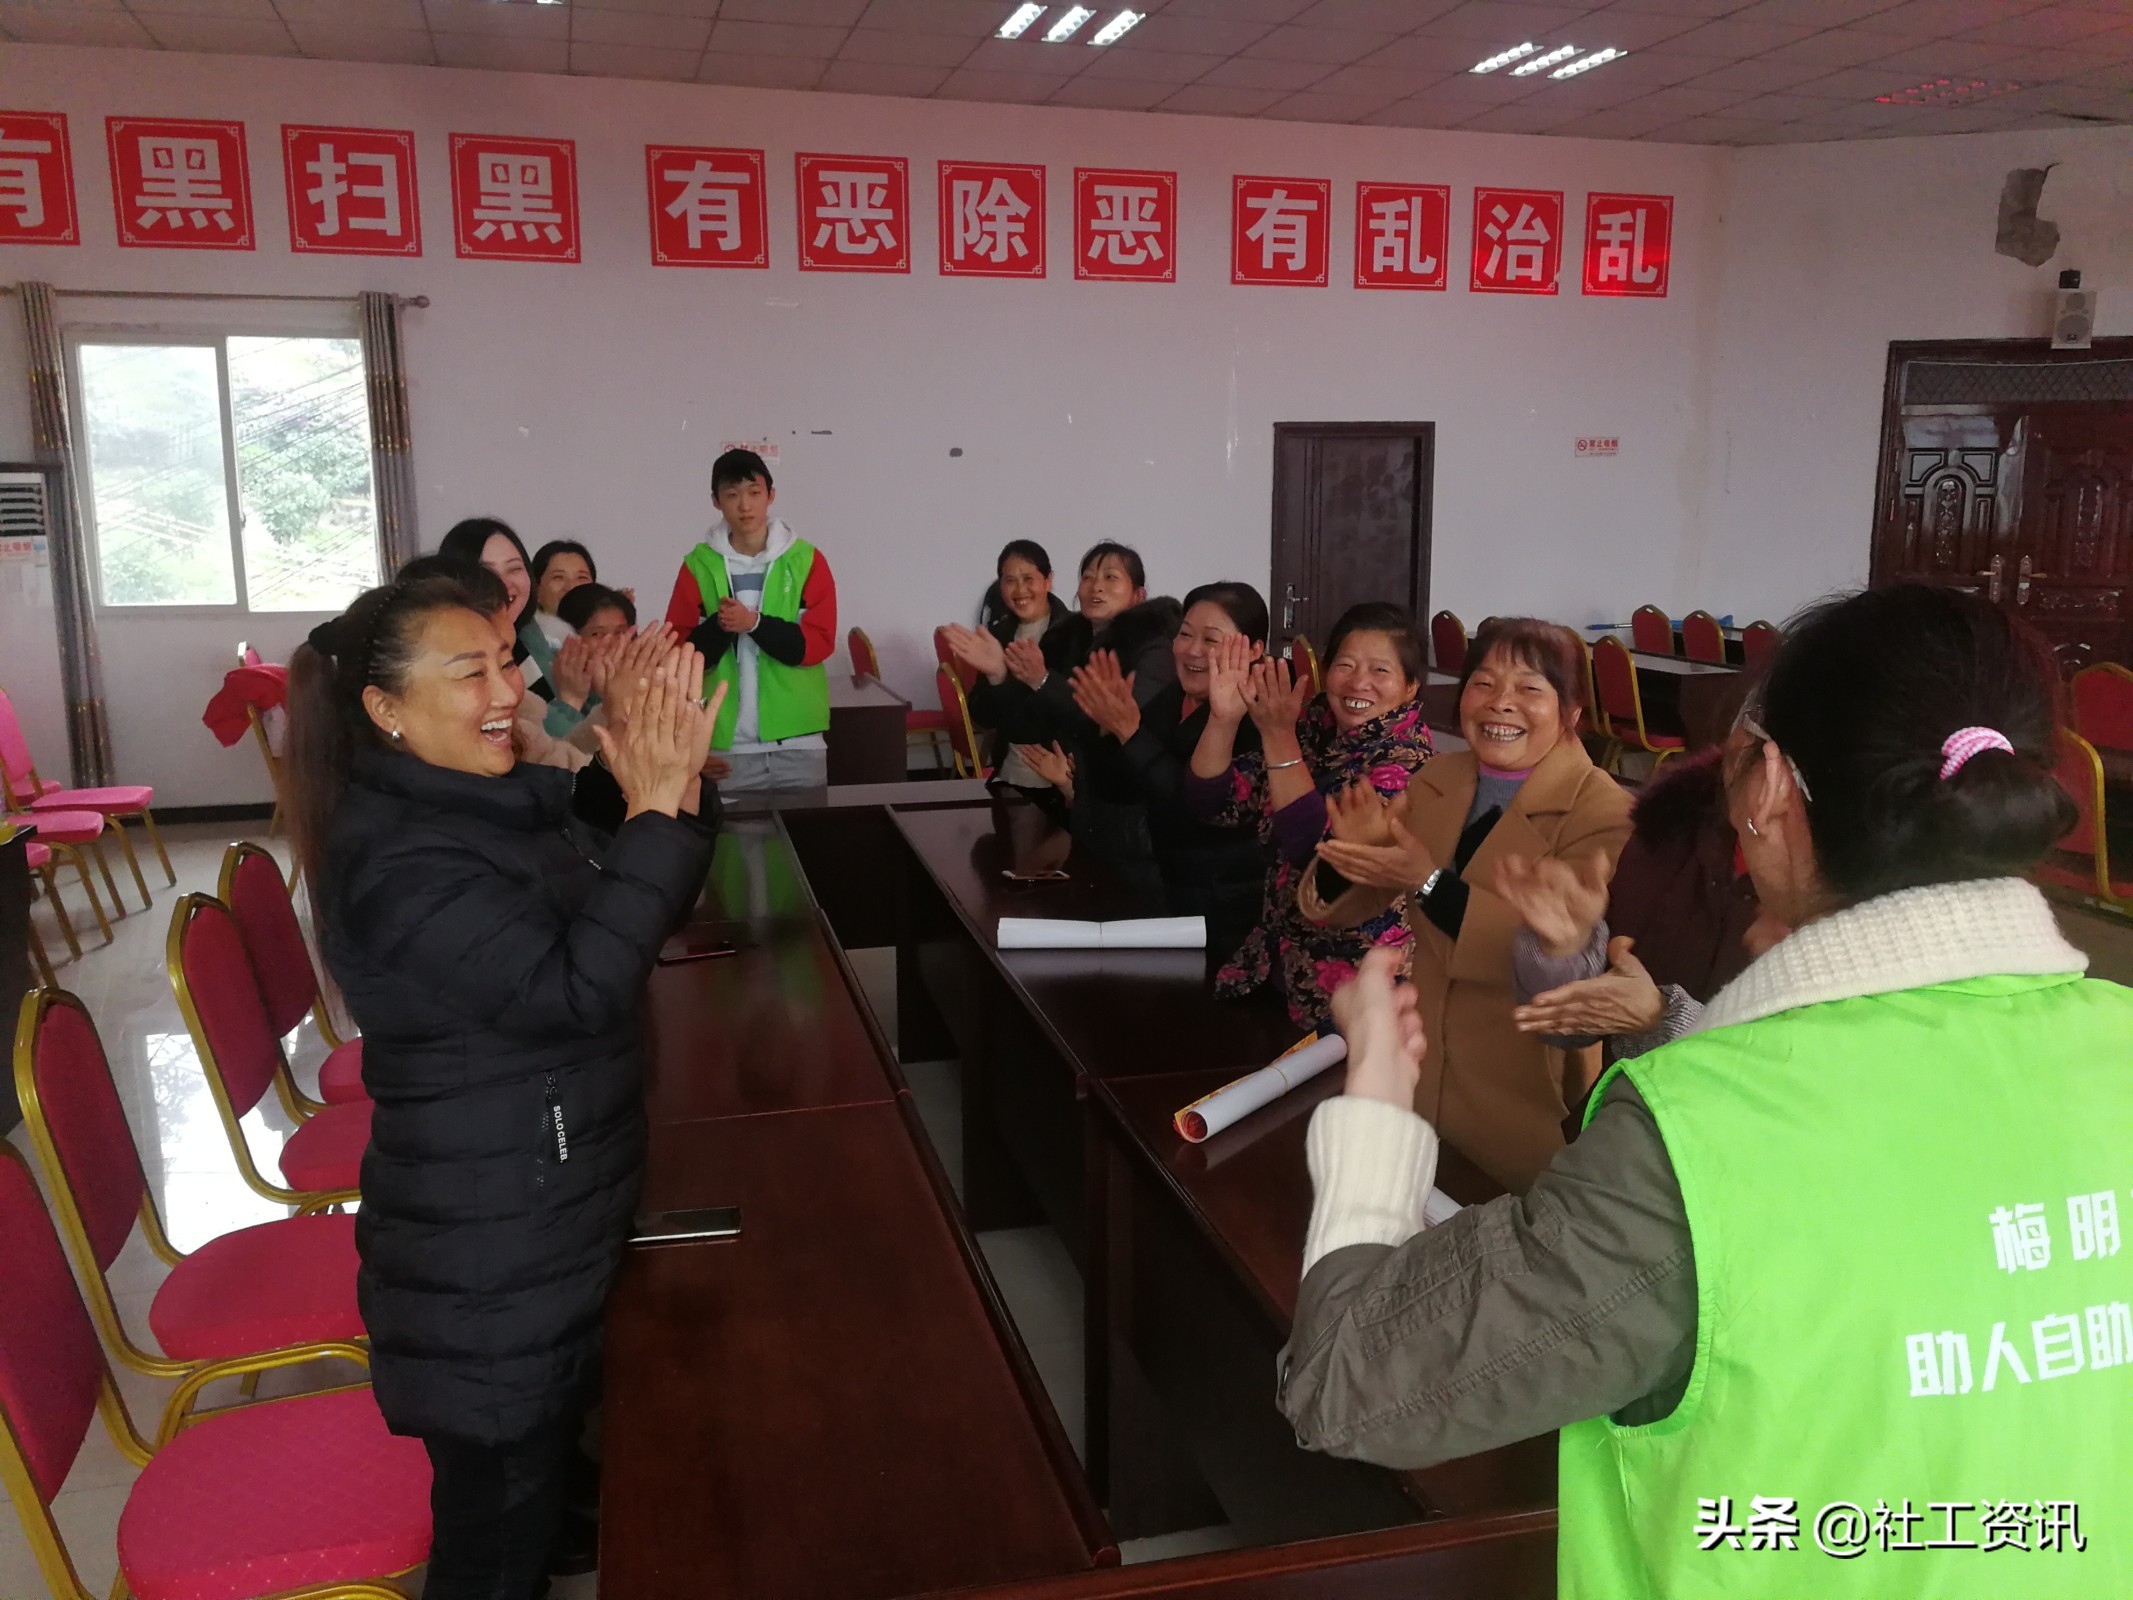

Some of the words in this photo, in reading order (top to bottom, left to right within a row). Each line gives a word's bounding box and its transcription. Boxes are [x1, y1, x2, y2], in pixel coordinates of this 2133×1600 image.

[663, 158, 1162, 267] 有恶除恶
[1245, 188, 1658, 286] 有乱治乱
[1988, 1189, 2133, 1275] 梅明
[1905, 1301, 2133, 1397] 助人自助
